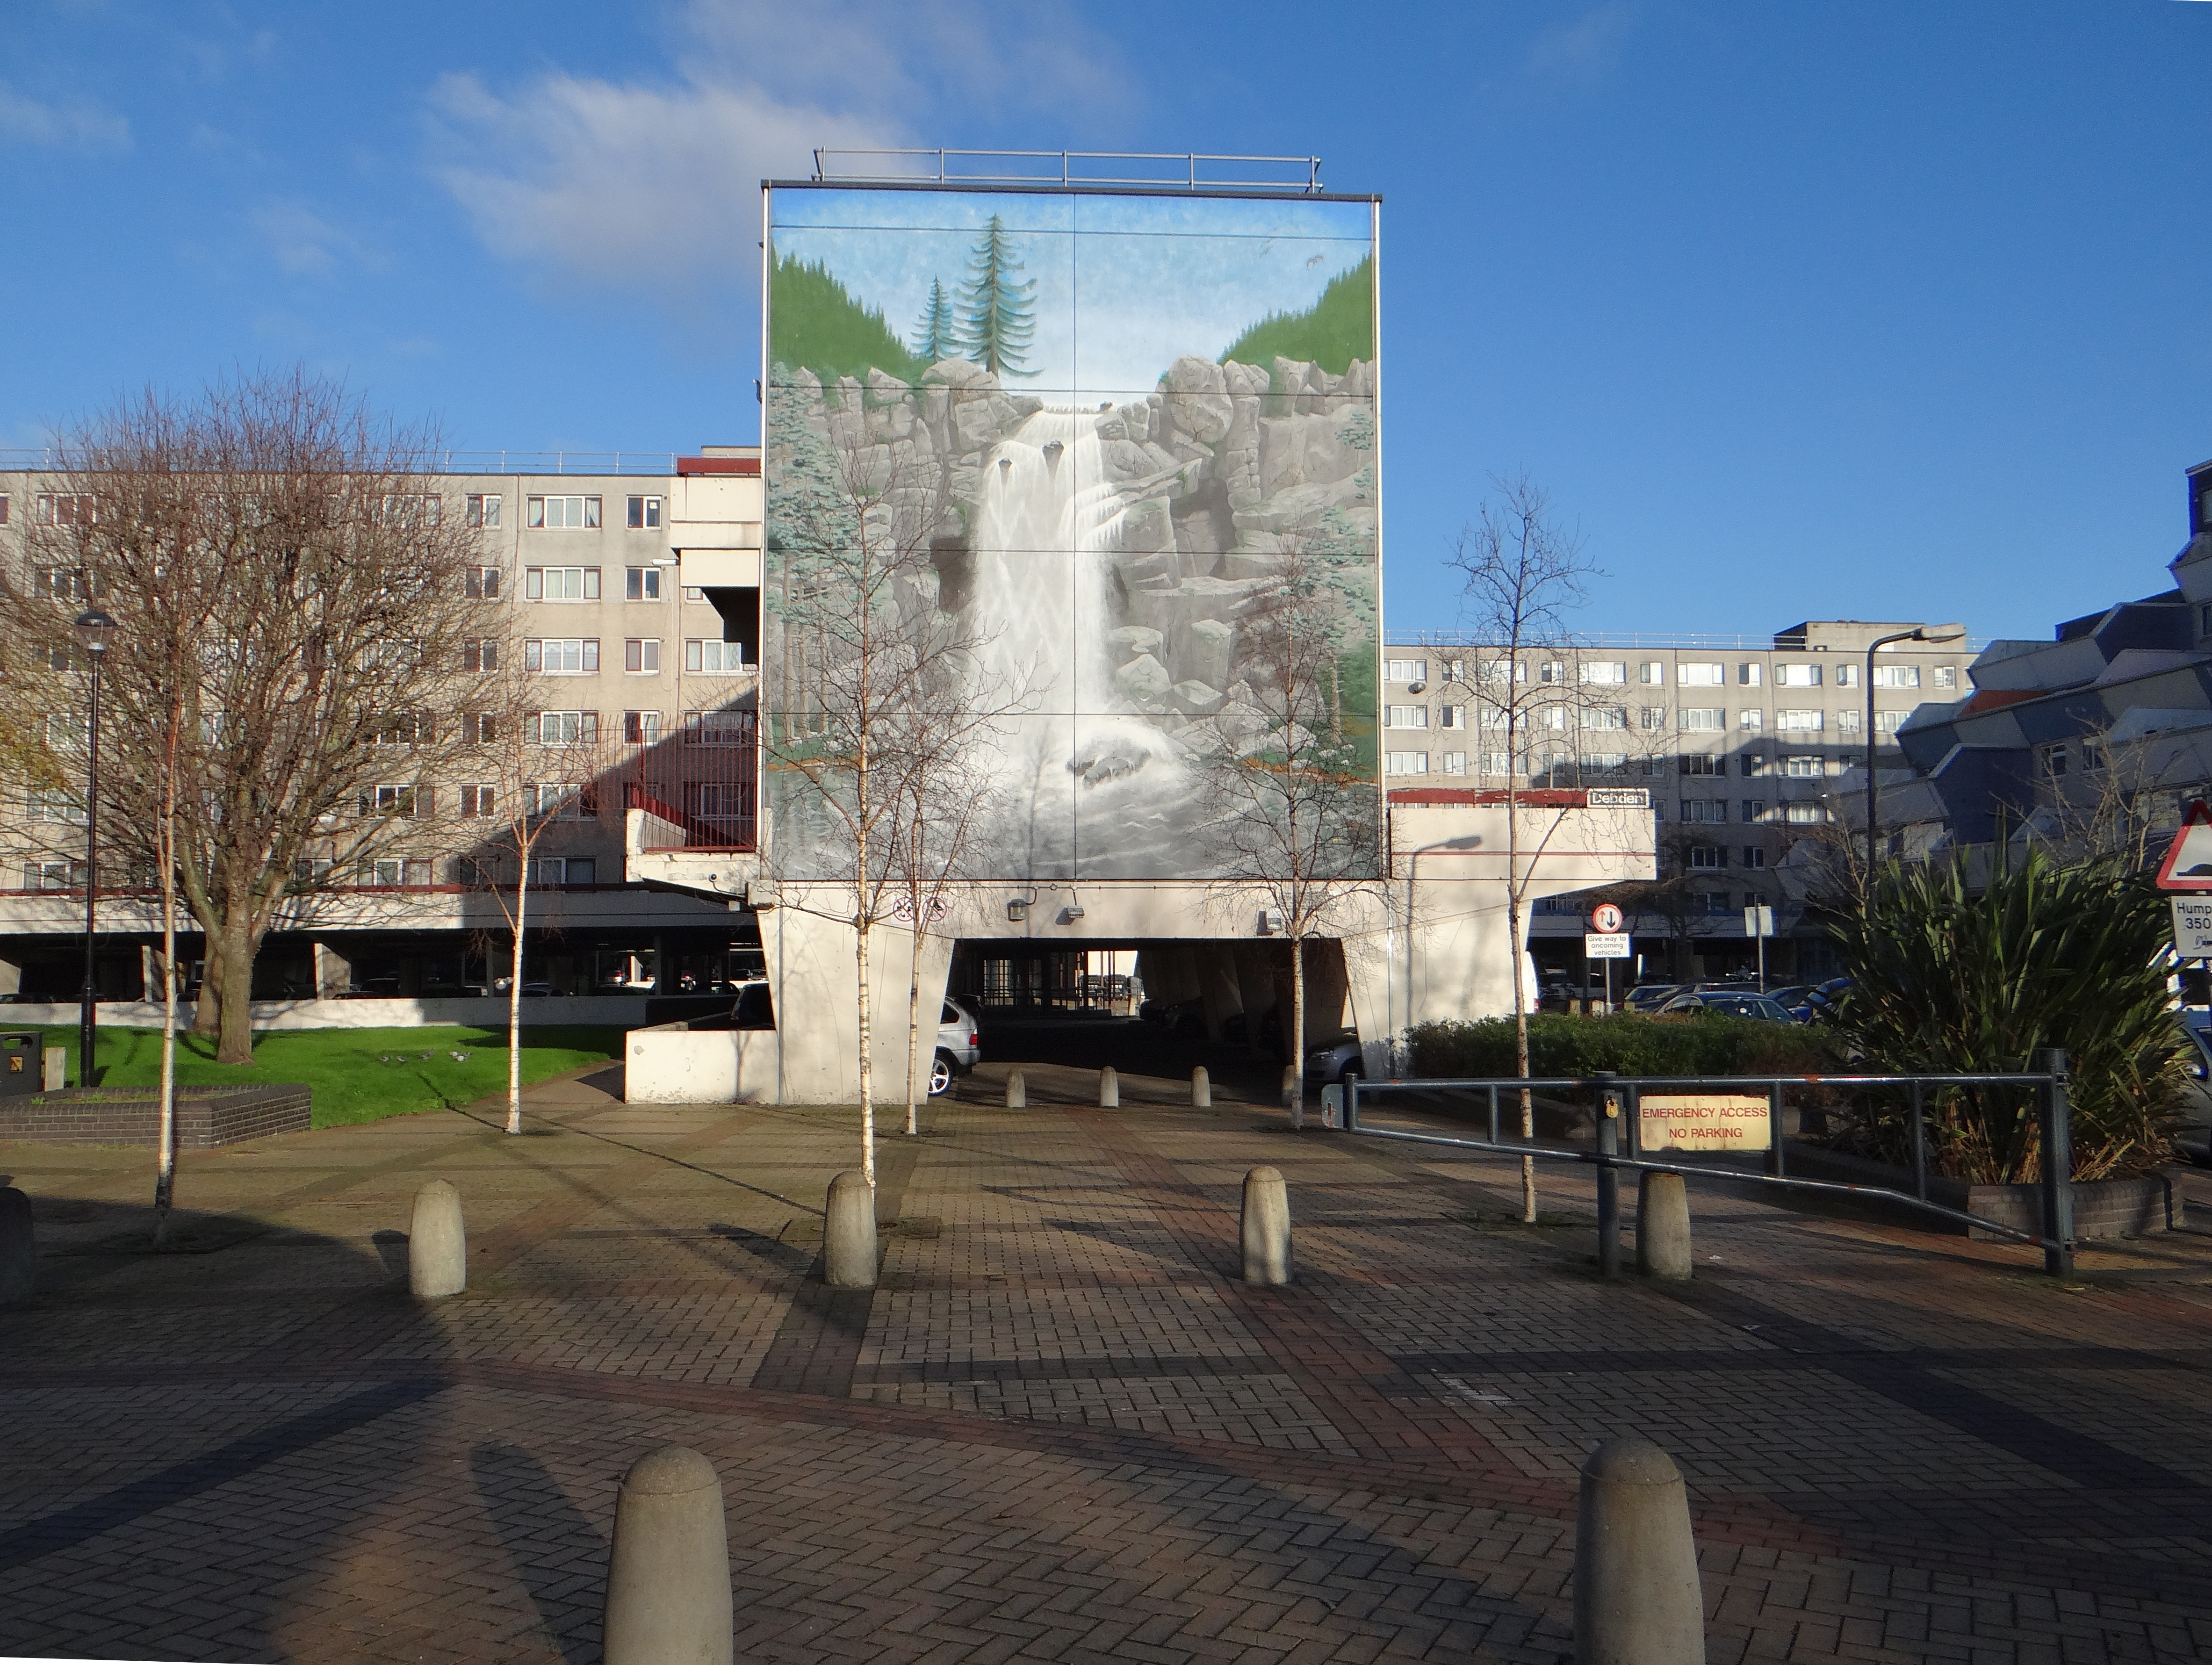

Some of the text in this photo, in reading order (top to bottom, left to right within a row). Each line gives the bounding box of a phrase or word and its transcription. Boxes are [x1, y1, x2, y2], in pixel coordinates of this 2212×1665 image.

[1592, 793, 1644, 804] Debden
[2185, 917, 2211, 929] 350
[1642, 1107, 1767, 1118] EMERGENCY ACCESS
[1669, 1127, 1743, 1138] NO PARKING
